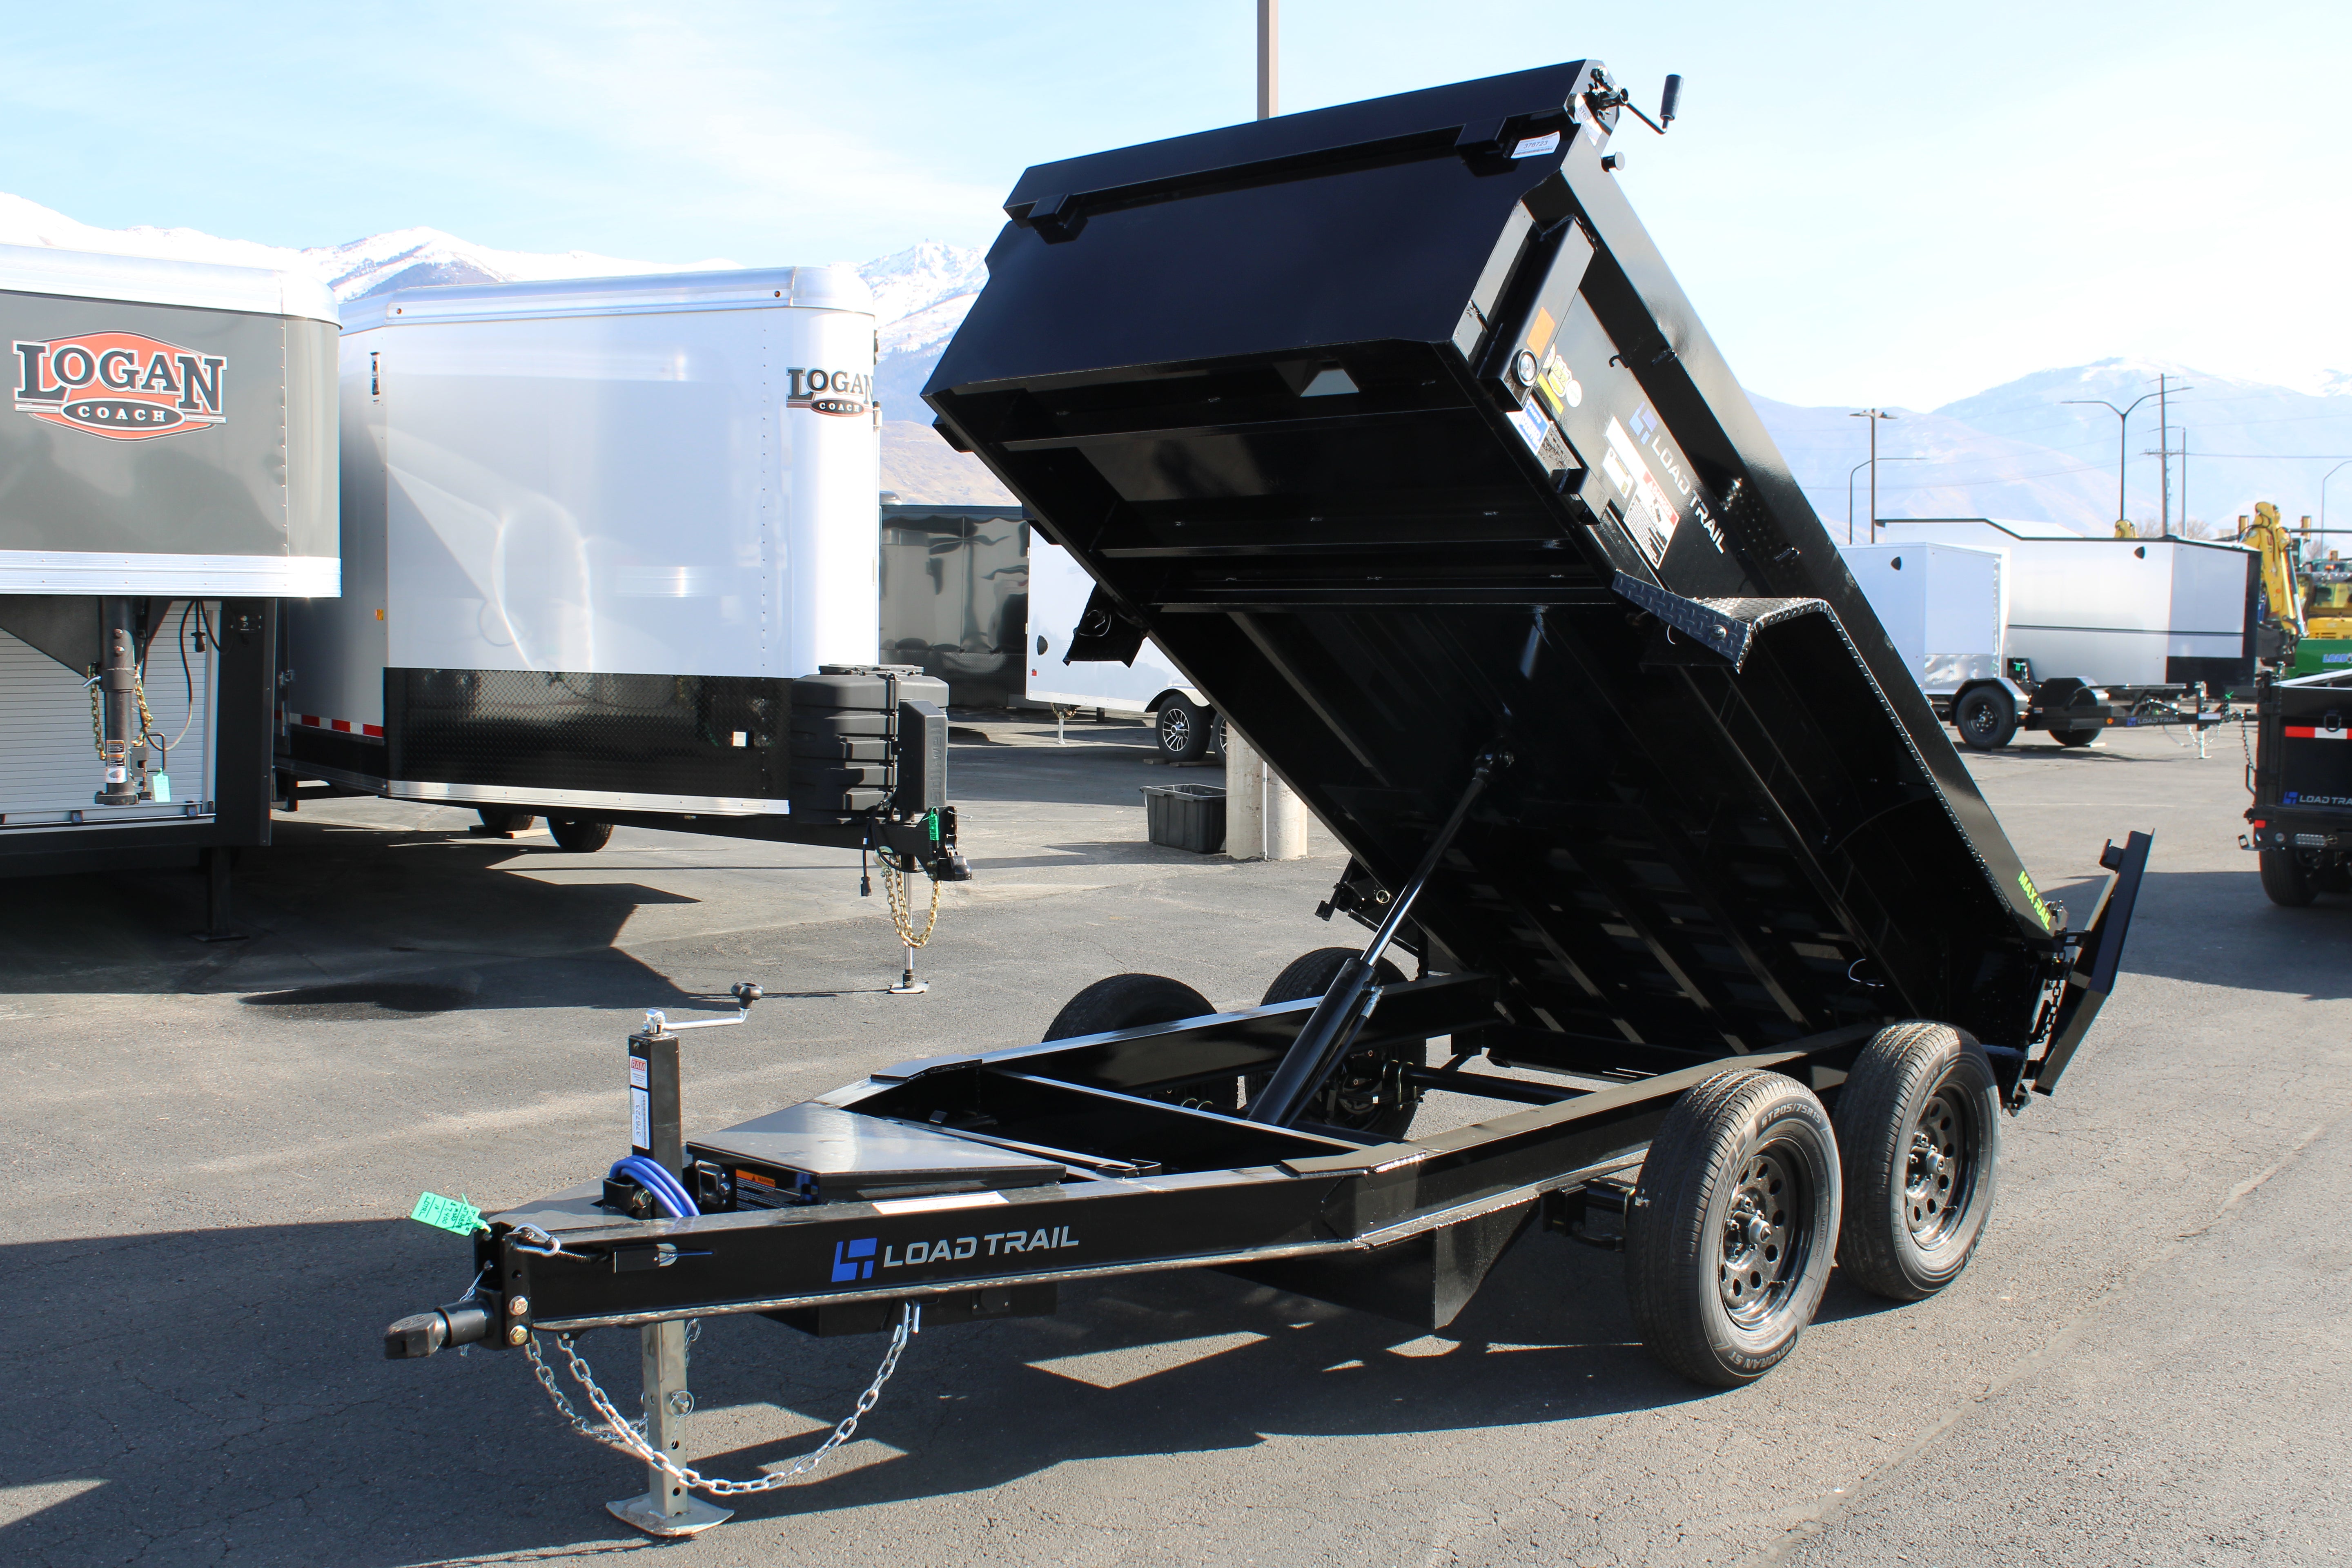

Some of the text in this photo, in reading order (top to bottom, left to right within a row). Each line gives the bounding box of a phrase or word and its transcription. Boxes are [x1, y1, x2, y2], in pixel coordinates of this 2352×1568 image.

[1523, 140, 1548, 149] 376723
[13, 341, 227, 414] LOGAN
[786, 367, 874, 405] LOGAN
[78, 405, 167, 422] COACH
[819, 402, 860, 412] COACH
[1650, 434, 1725, 554] LOAD TRAIL
[1651, 486, 1674, 518] DANGER
[2299, 795, 2329, 804] LOAD
[2017, 871, 2051, 930] MAX RAIL
[632, 1061, 646, 1071] RAM
[1761, 1103, 1821, 1128] ST205/75R15
[884, 1226, 1079, 1268] LOAD TRAIL
[1728, 1351, 1744, 1365] ST
[1743, 1335, 1795, 1369] SONORAN
